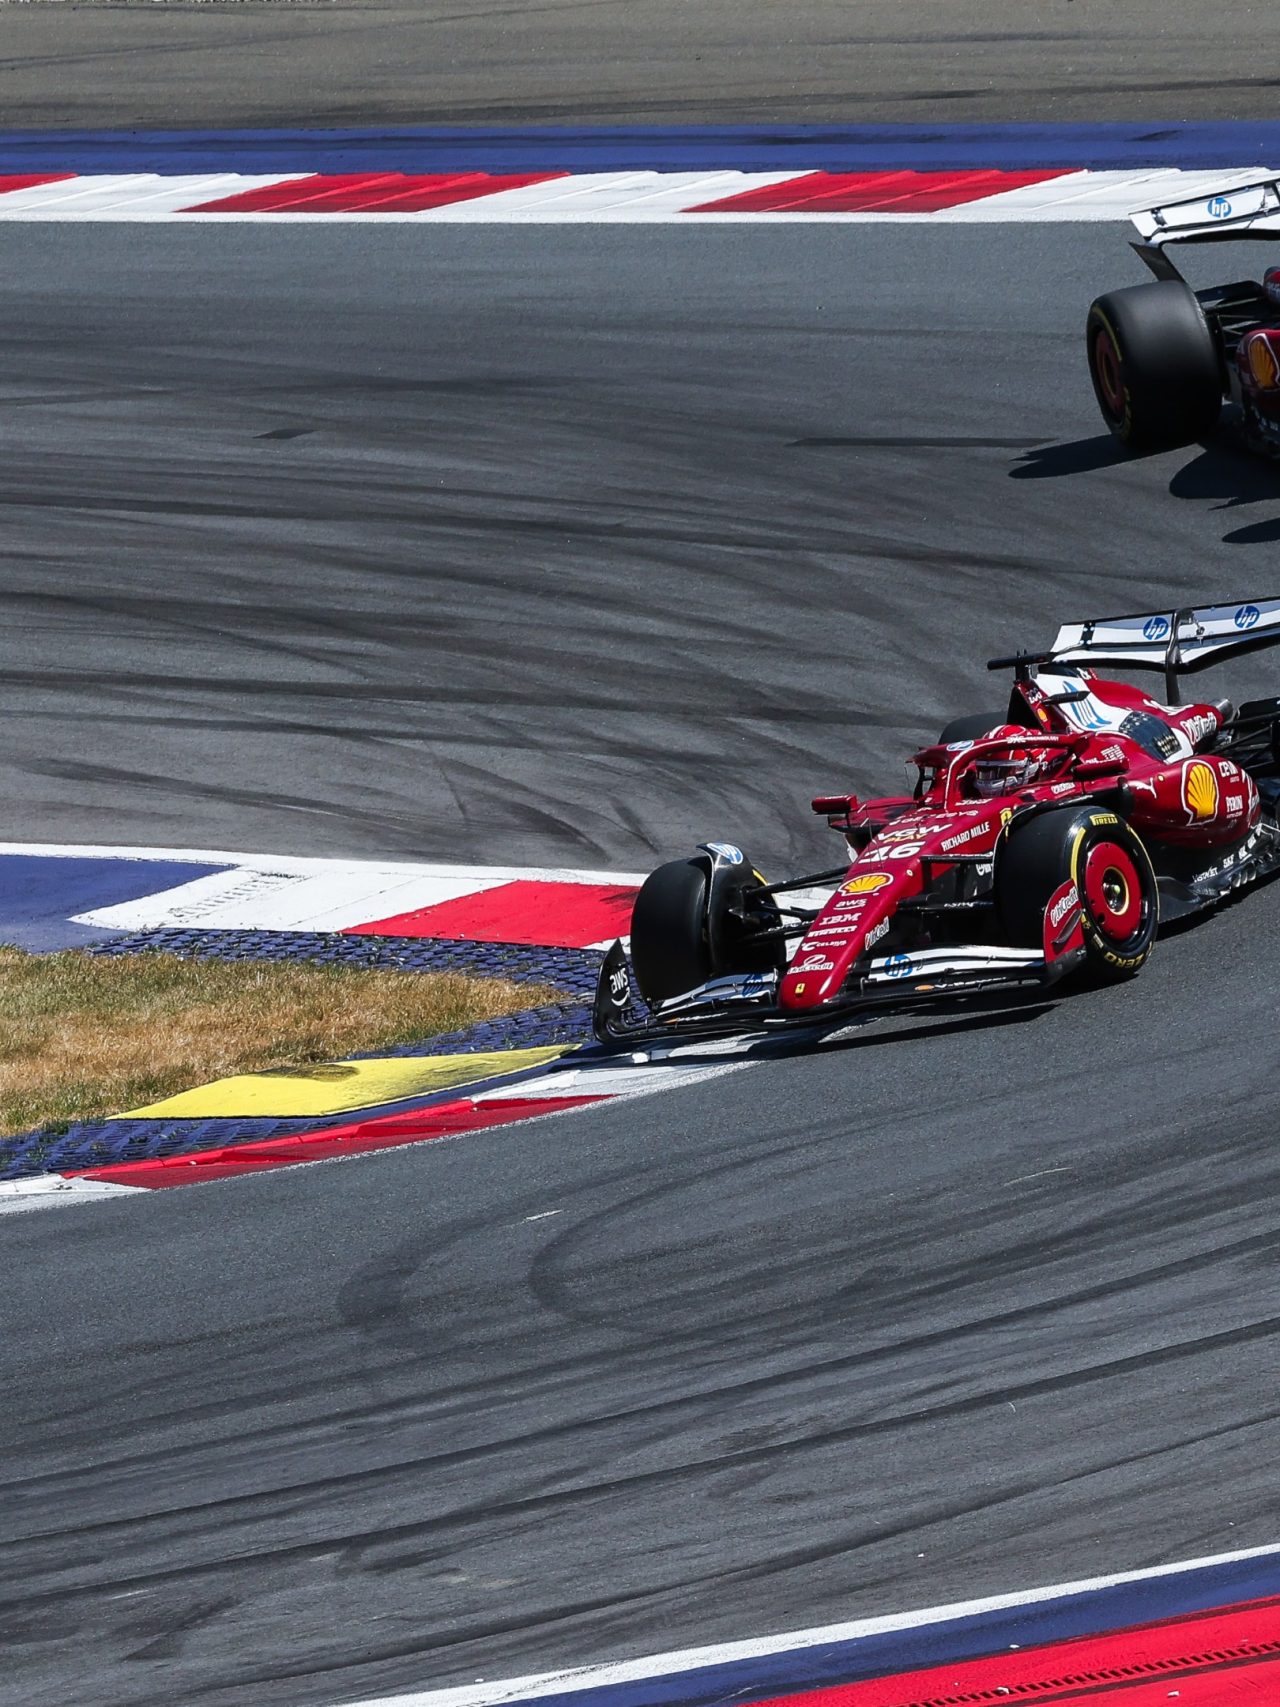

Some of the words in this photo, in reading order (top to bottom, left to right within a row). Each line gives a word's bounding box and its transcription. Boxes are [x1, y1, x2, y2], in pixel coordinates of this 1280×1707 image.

[1210, 197, 1230, 218] hp
[1237, 606, 1258, 628] hp
[1146, 618, 1167, 640] hp
[1090, 813, 1118, 826] PIRELLI
[878, 824, 952, 840] VGW
[941, 830, 970, 852] RICHARD
[971, 821, 991, 838] MILLE
[857, 841, 925, 863] 16
[836, 899, 867, 908] aws
[819, 913, 862, 925] IBM
[1104, 951, 1144, 969] ZERO
[609, 968, 628, 993] aws
